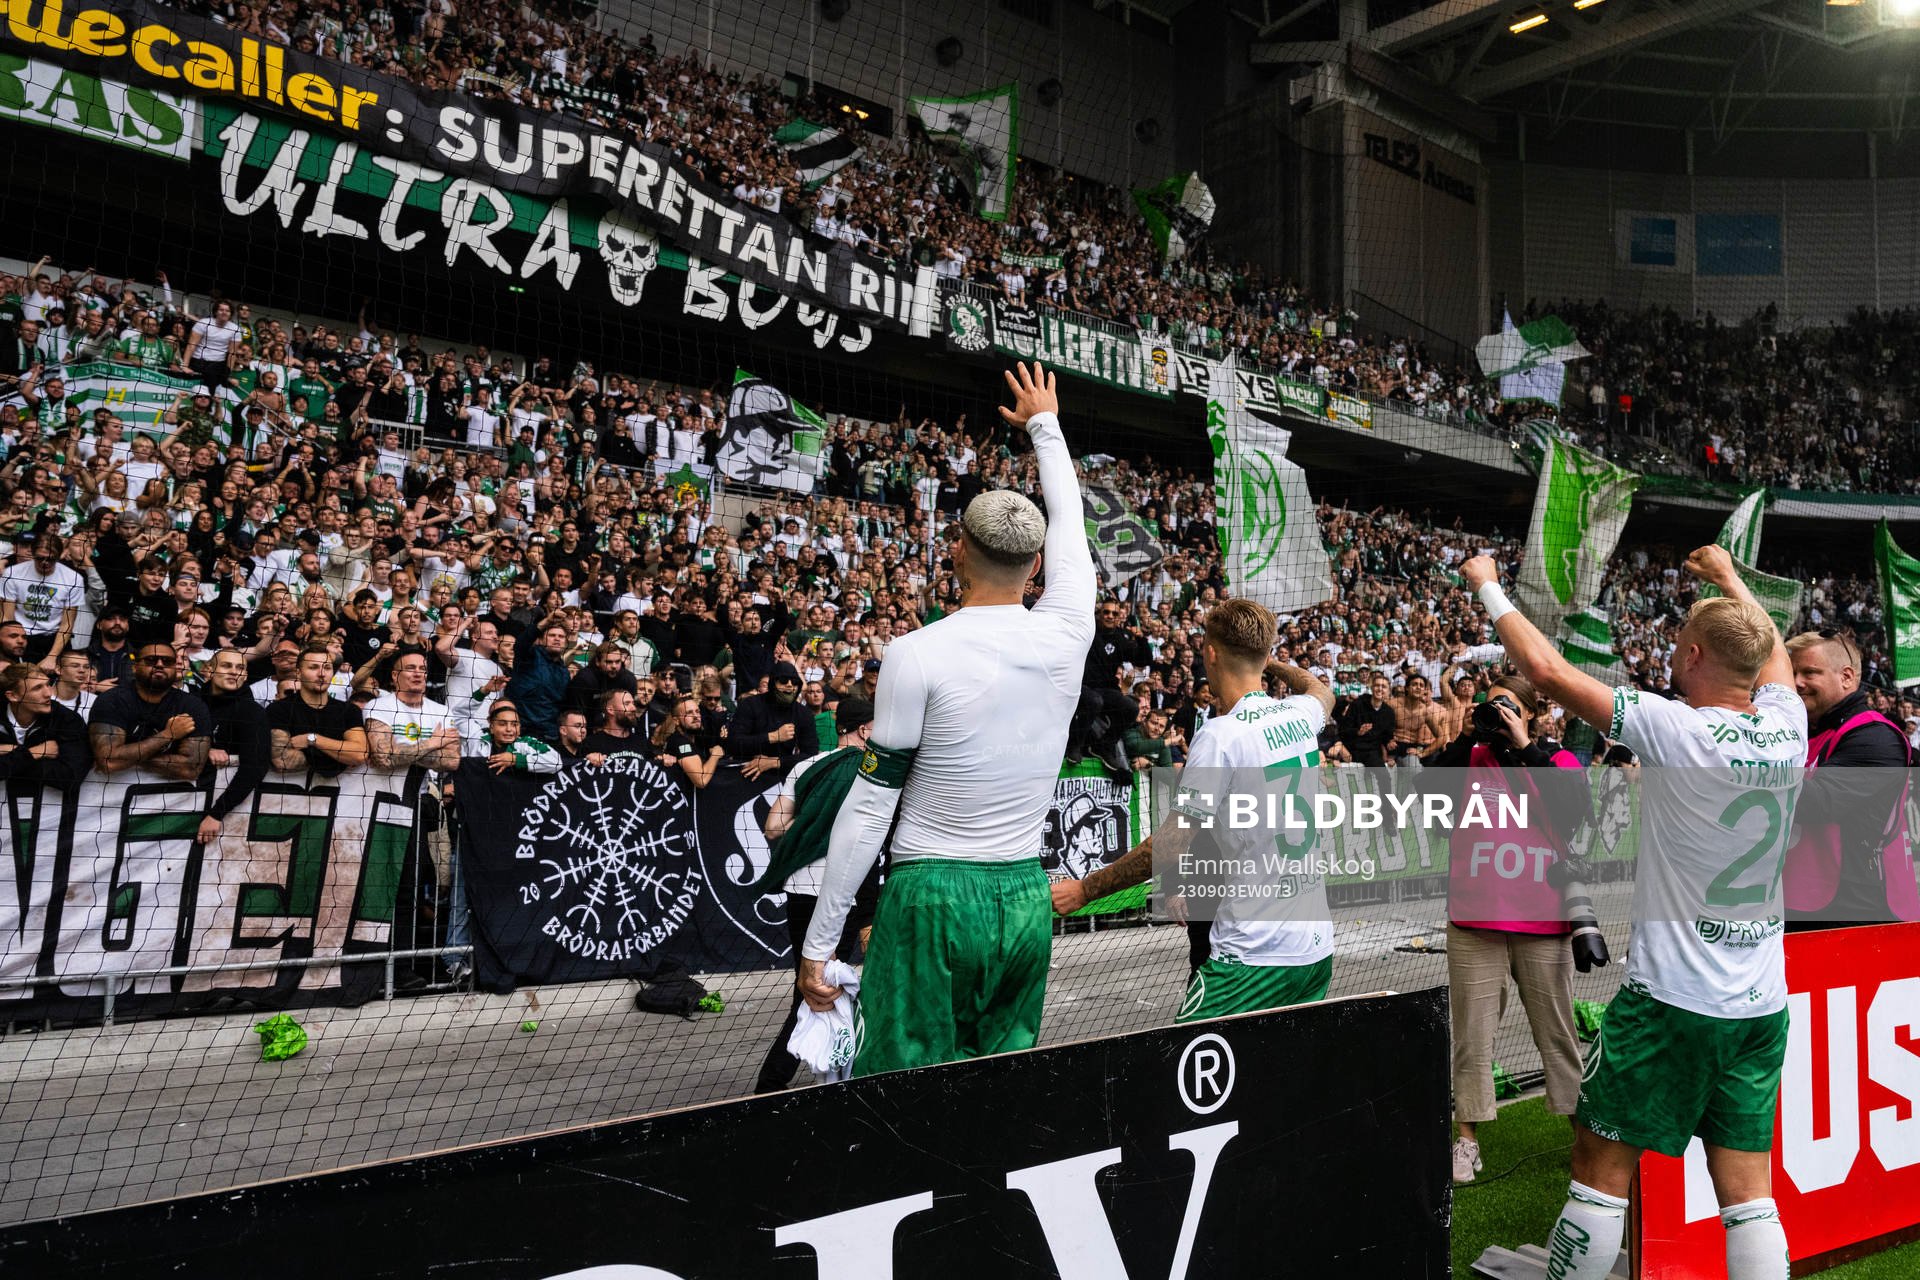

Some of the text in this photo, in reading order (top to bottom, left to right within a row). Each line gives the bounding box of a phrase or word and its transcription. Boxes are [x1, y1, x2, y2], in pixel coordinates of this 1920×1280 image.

[1364, 133, 1421, 179] TELE2
[219, 111, 581, 291] ULTRA
[436, 105, 828, 294] SUPERETTAN
[519, 882, 541, 906] 20
[1470, 841, 1558, 883] FOT
[542, 866, 704, 963] BRÖDRAFÖRBANDET
